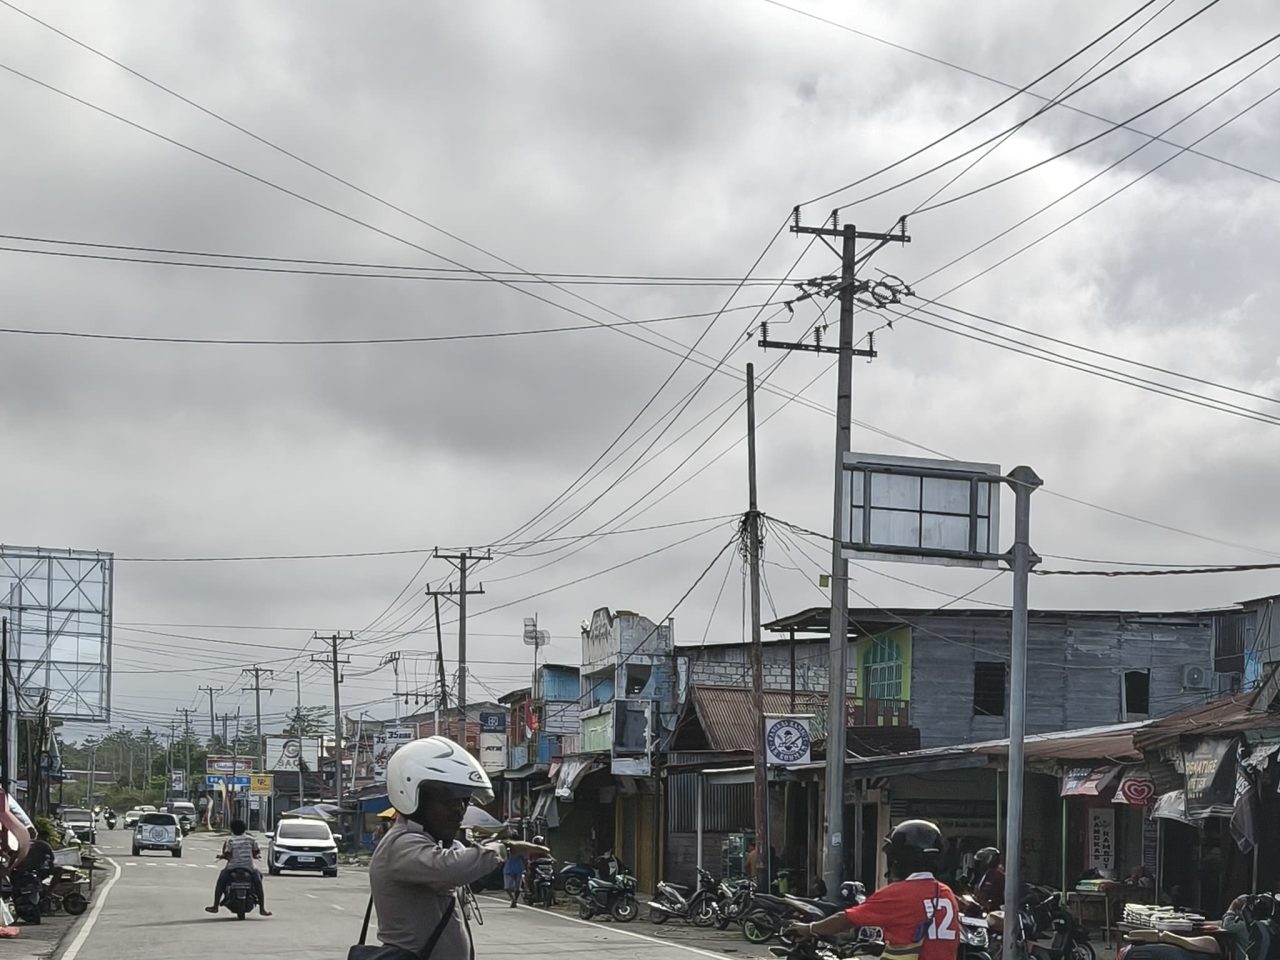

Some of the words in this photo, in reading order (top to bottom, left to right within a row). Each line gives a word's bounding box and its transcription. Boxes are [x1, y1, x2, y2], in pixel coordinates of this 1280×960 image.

[1093, 815, 1101, 861] PANGKAS
[1102, 831, 1111, 869] RAMBUT
[923, 897, 956, 940] 12
